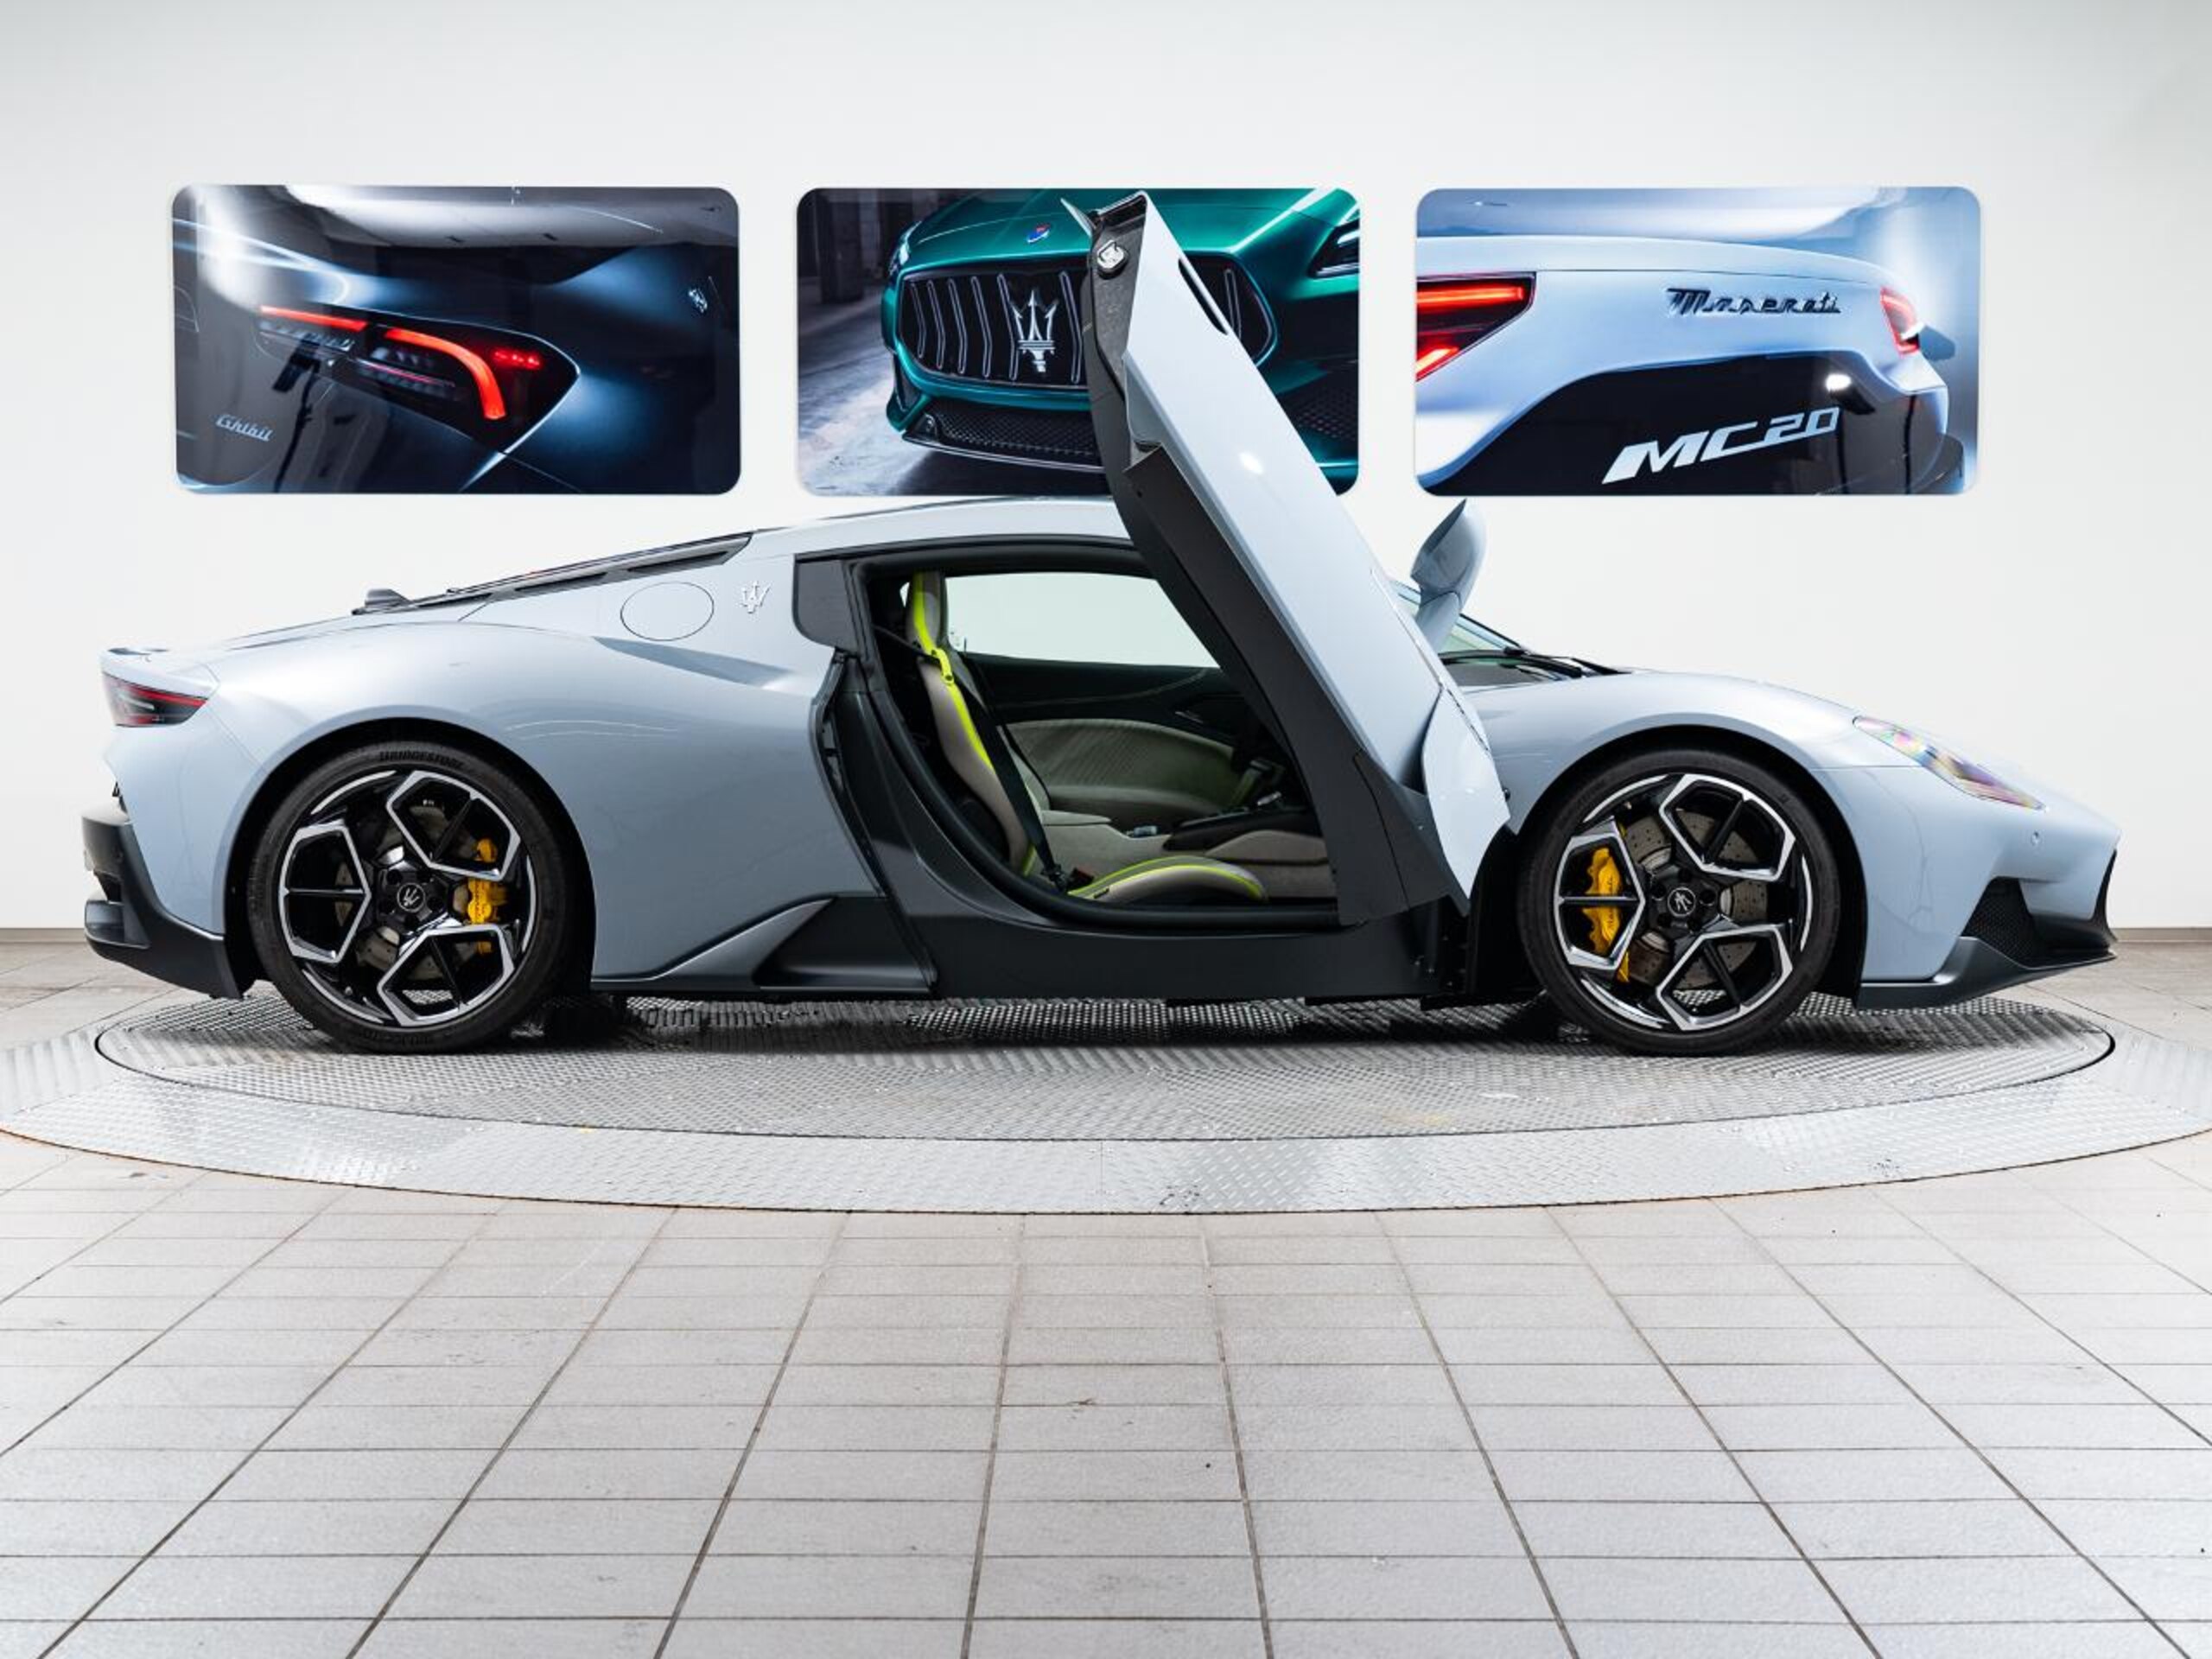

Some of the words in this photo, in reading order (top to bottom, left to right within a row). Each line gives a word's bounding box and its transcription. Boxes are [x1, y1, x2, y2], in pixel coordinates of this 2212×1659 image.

[1667, 288, 1841, 315] Maserati
[215, 414, 273, 442] Ghibli
[1601, 406, 1840, 484] MC20
